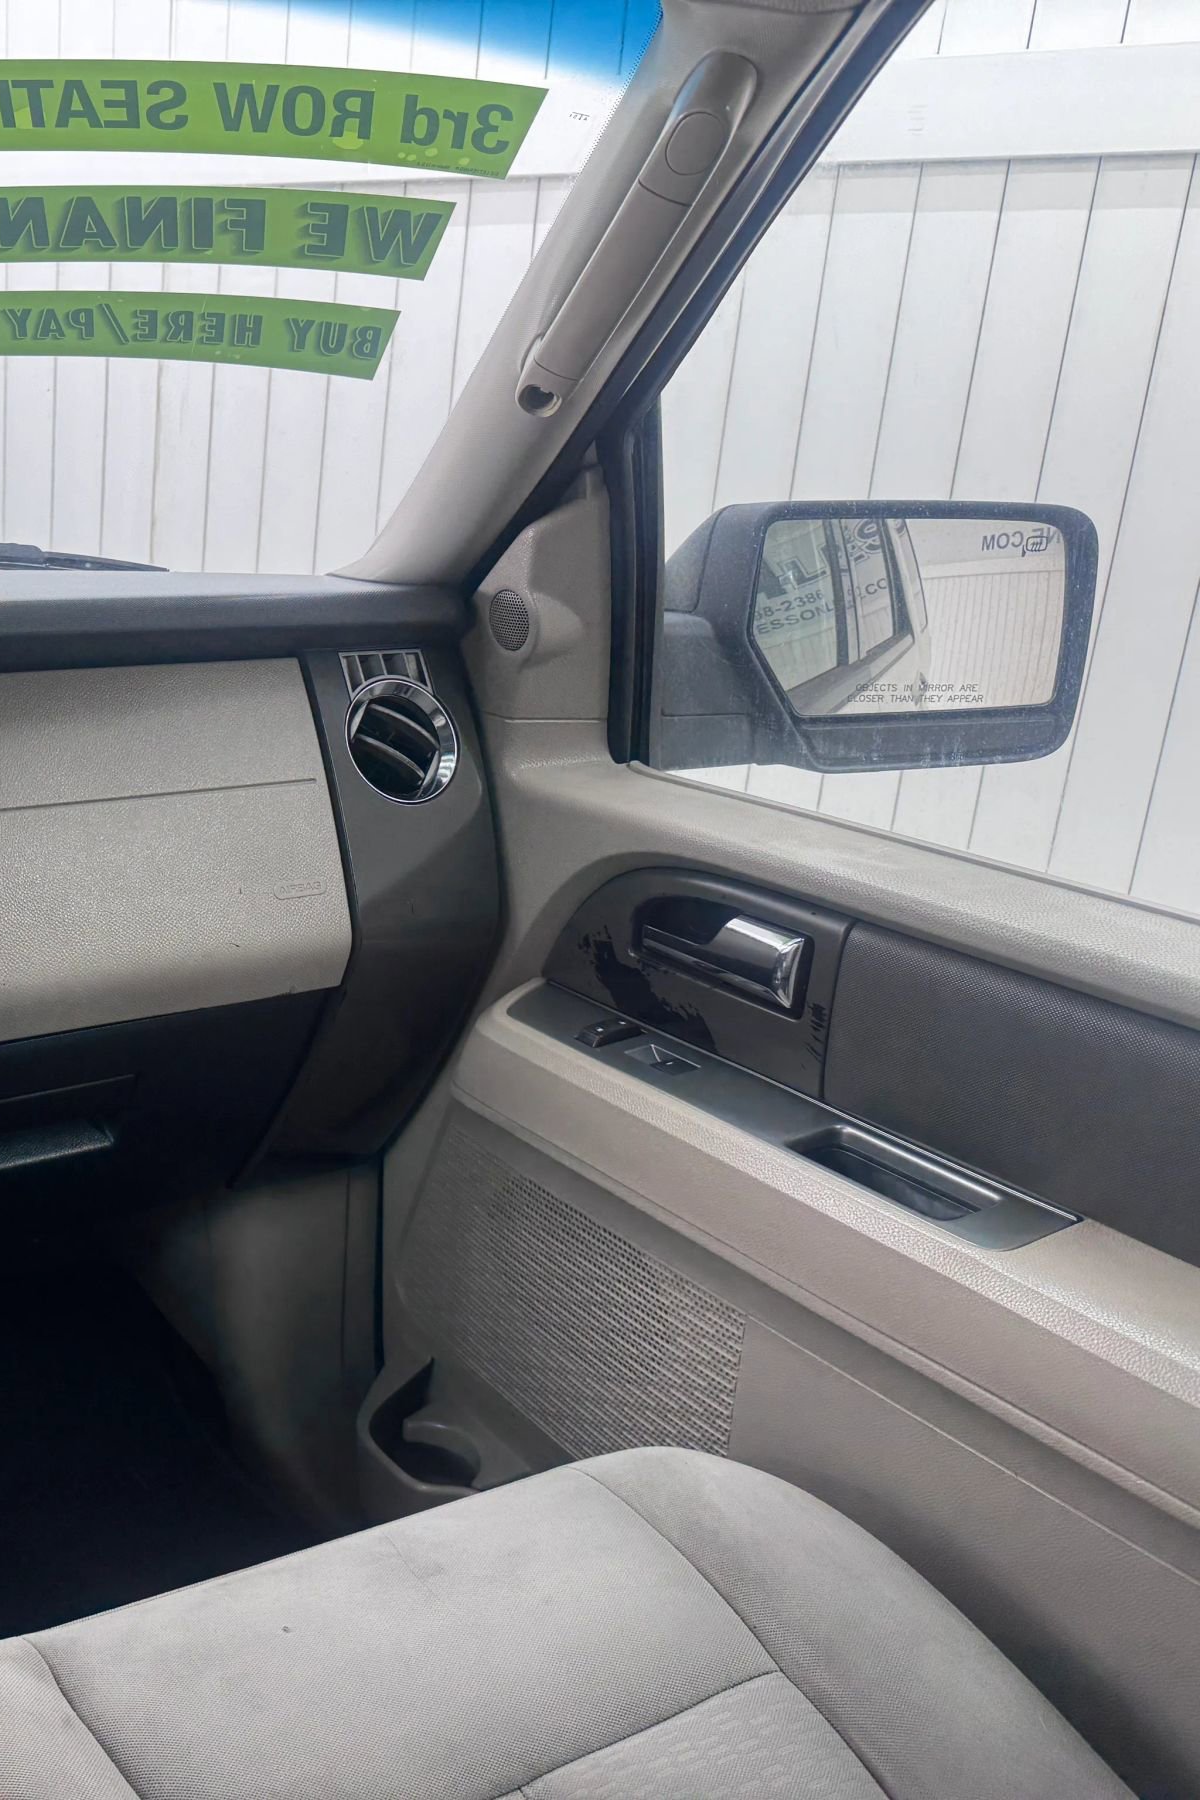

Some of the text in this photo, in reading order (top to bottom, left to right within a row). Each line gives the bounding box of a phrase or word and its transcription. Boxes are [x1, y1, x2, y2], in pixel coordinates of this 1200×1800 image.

[855, 683, 979, 693] OBJECTS IN MIRROR ARE
[890, 694, 914, 703] THAN
[919, 694, 943, 703] THEY
[947, 694, 984, 703] APPEAR
